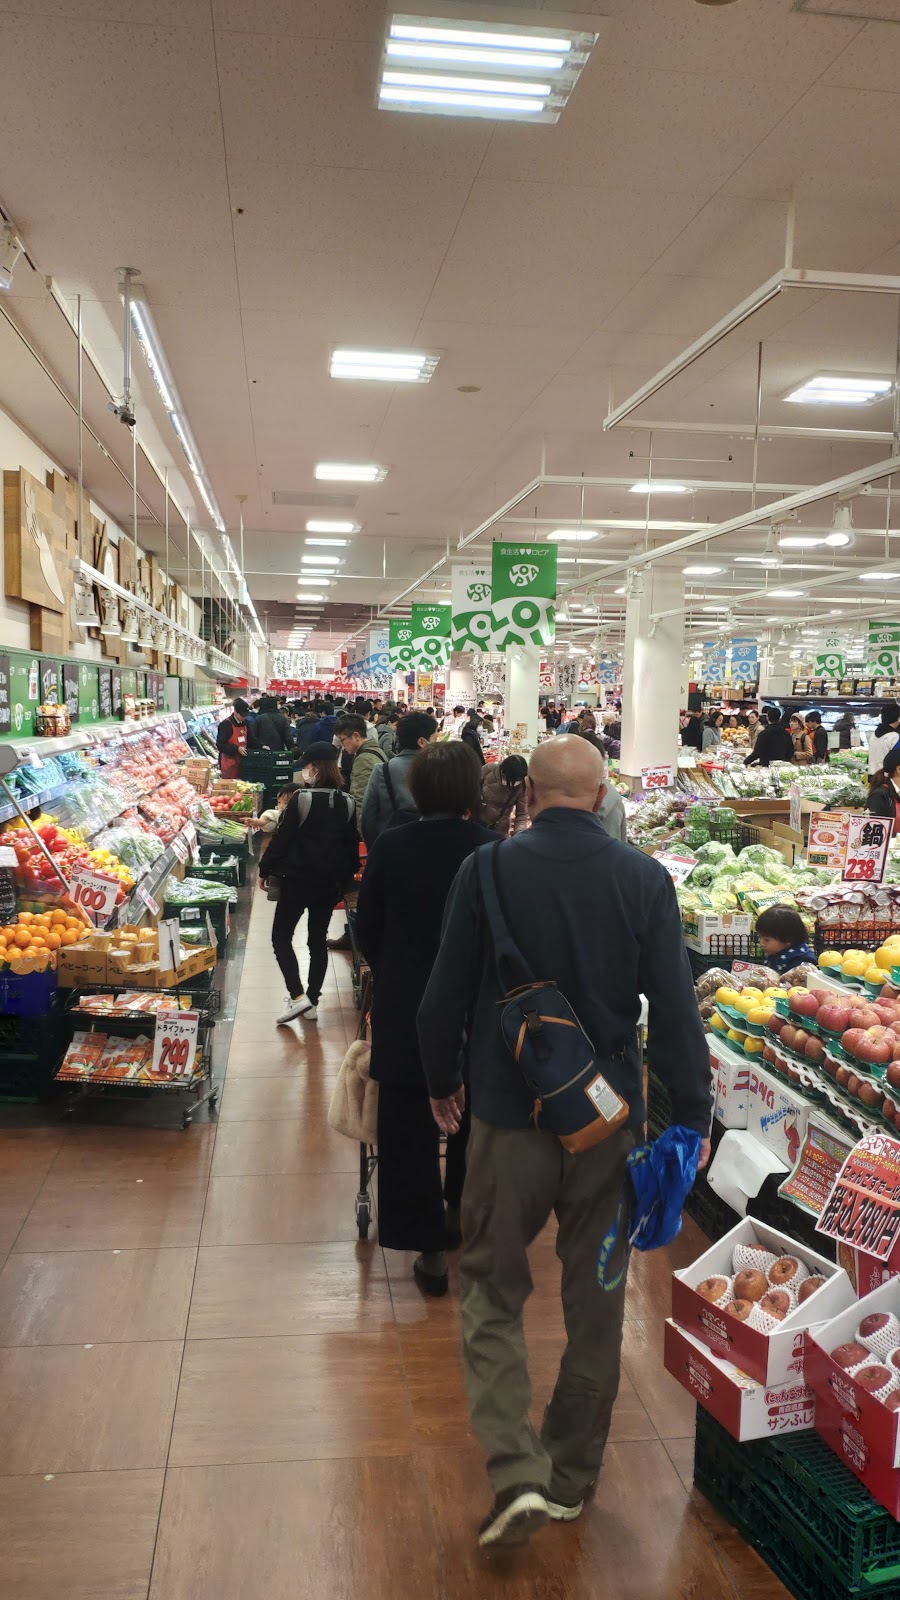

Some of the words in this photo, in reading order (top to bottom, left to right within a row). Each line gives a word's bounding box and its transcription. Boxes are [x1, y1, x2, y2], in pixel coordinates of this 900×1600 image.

[500, 548, 519, 556] 食生活
[646, 775, 668, 787] 299
[861, 822, 885, 848] 鍋
[845, 858, 875, 879] 238
[74, 883, 106, 911] 100
[60, 963, 104, 973] ベビーコーン
[157, 1024, 196, 1035] ドライフルーツ
[159, 1036, 190, 1075] 299
[767, 1410, 814, 1431] サンふじ
